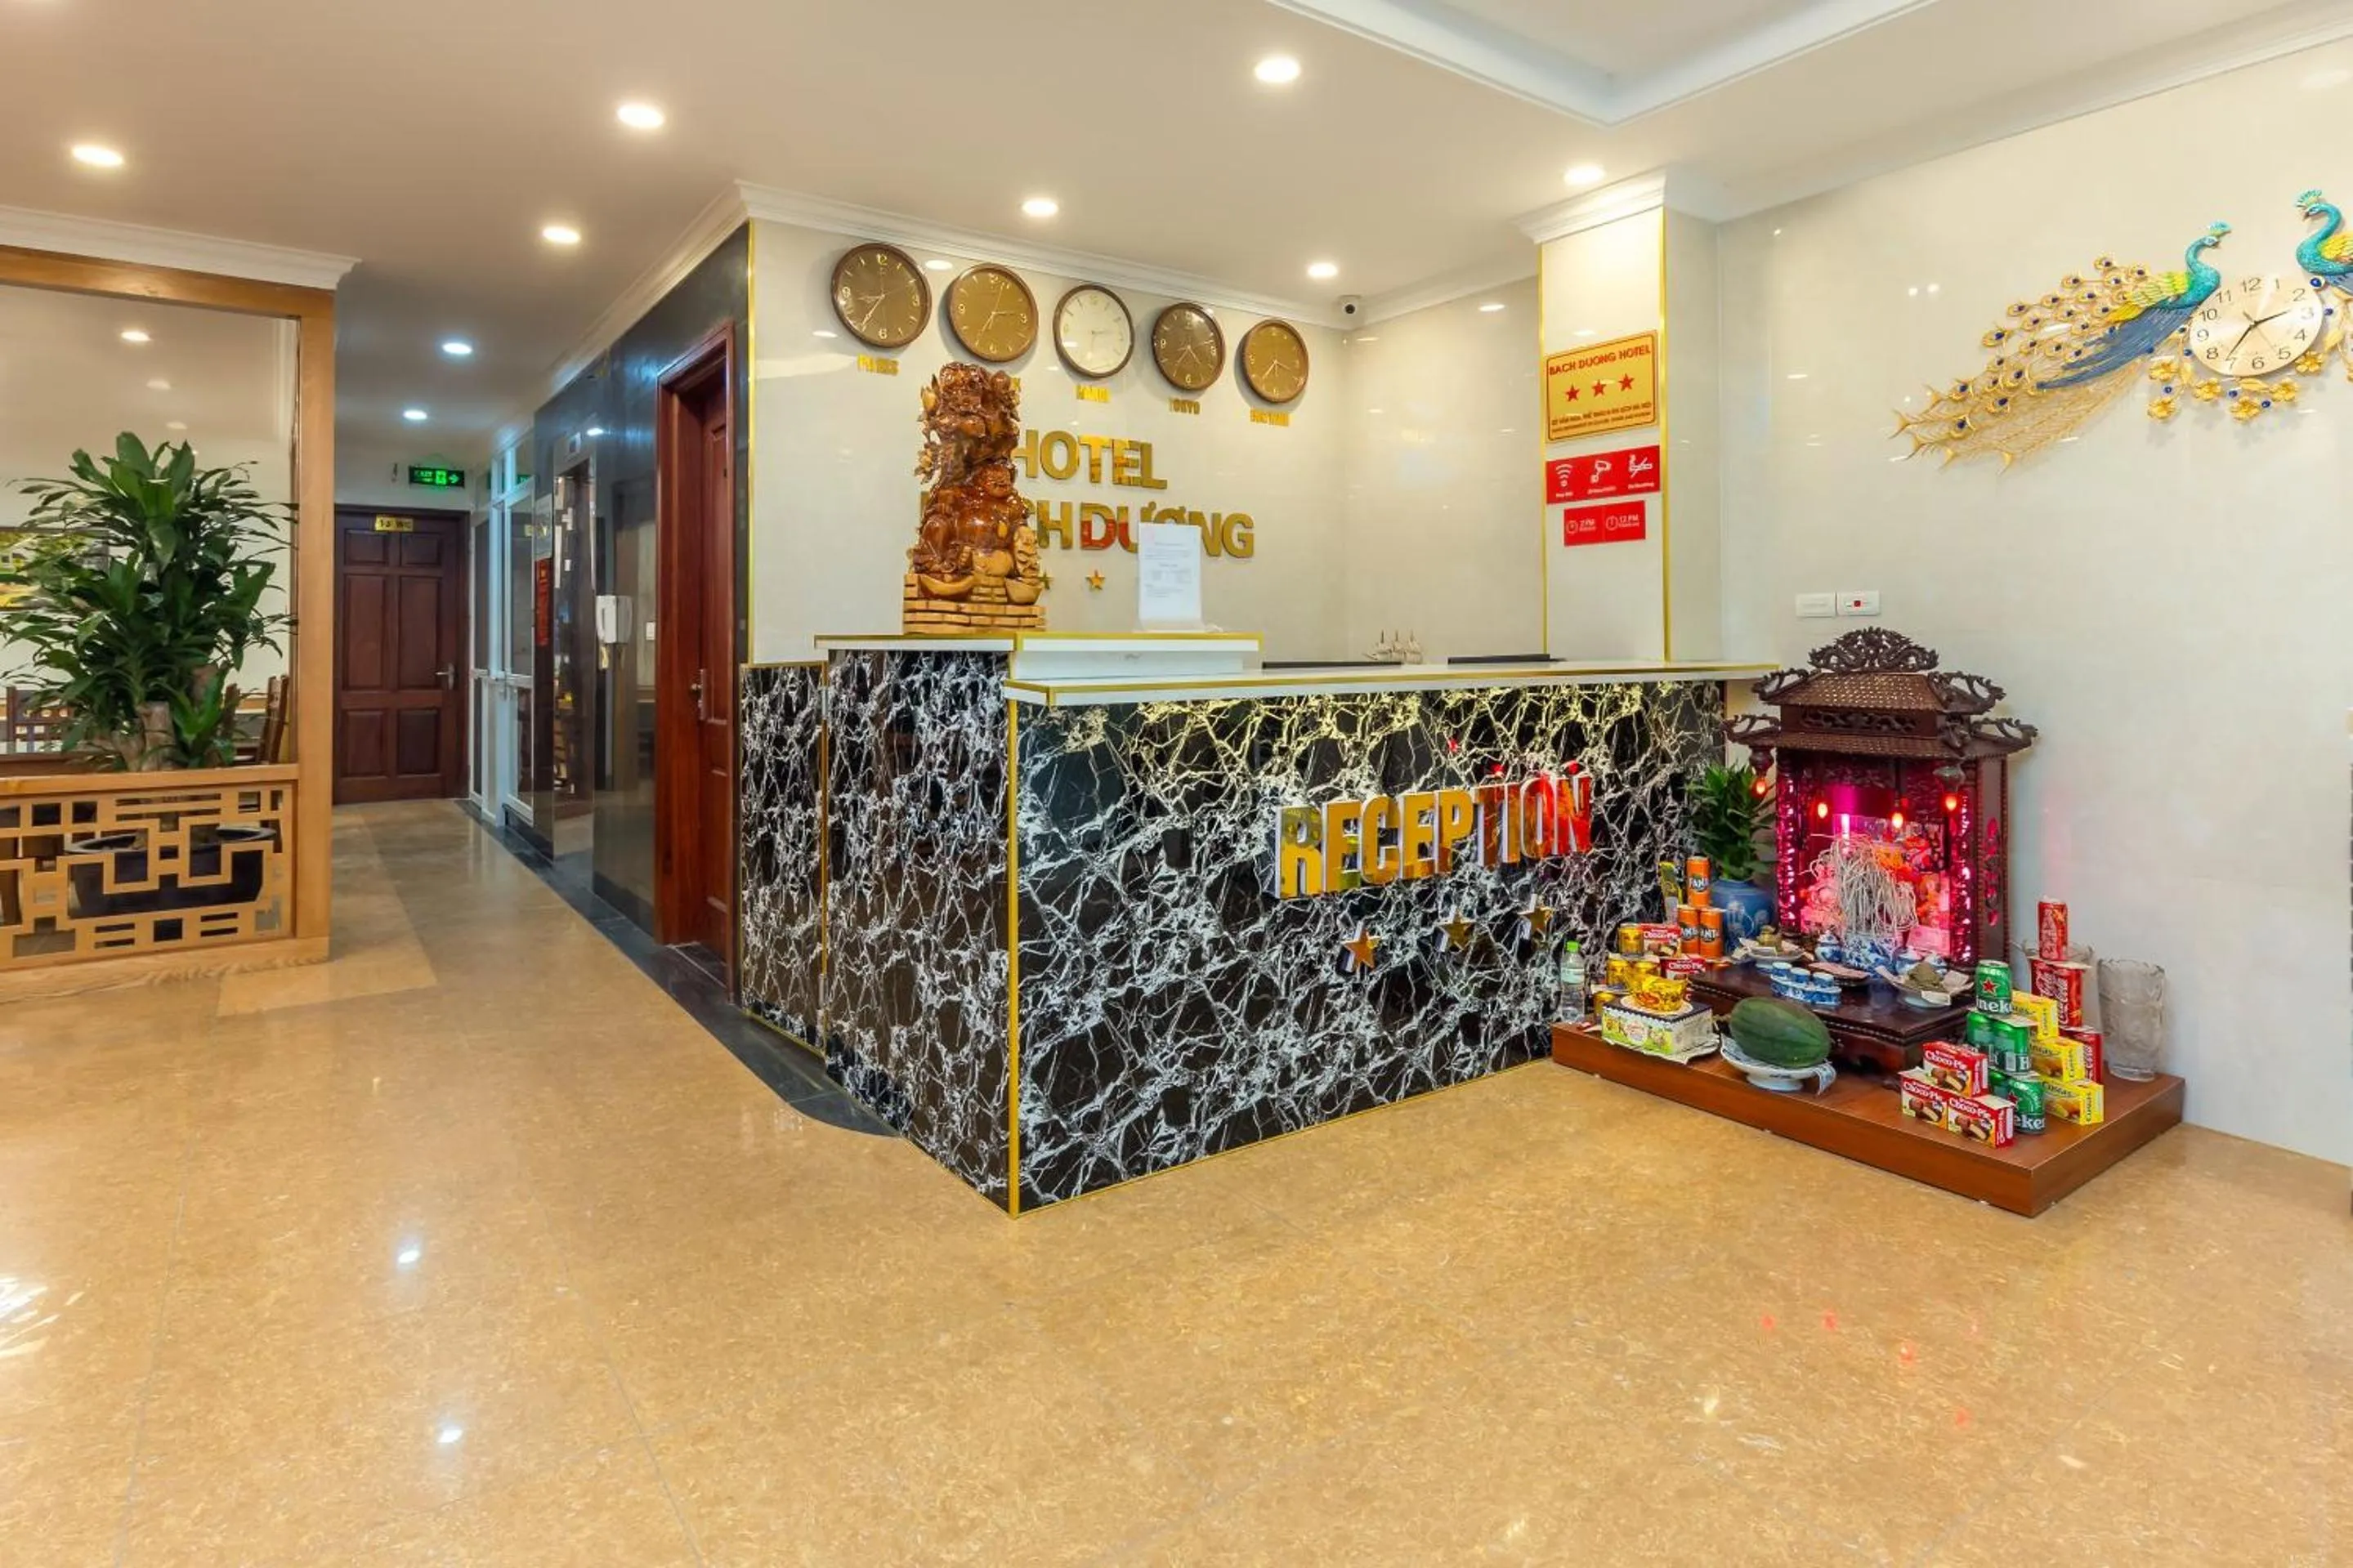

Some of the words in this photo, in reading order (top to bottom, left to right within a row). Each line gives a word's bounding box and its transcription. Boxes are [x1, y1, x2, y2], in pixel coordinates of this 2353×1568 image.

[2241, 277, 2261, 293] 12
[2275, 278, 2280, 289] 1
[2216, 289, 2232, 303] 11
[2293, 288, 2306, 302] 2
[2200, 308, 2217, 321] 10
[2301, 306, 2315, 319] 3
[2197, 328, 2209, 342] 9
[2293, 328, 2306, 342] 4
[1549, 362, 1576, 375] BACH
[1618, 344, 1651, 360] HOTEL
[2206, 347, 2219, 360] 8
[2278, 346, 2291, 360] 5
[2227, 356, 2238, 369] 7
[2252, 356, 2265, 369] 6
[1012, 429, 1168, 489] HOTEL
[1275, 773, 1592, 899] RECEPTION
